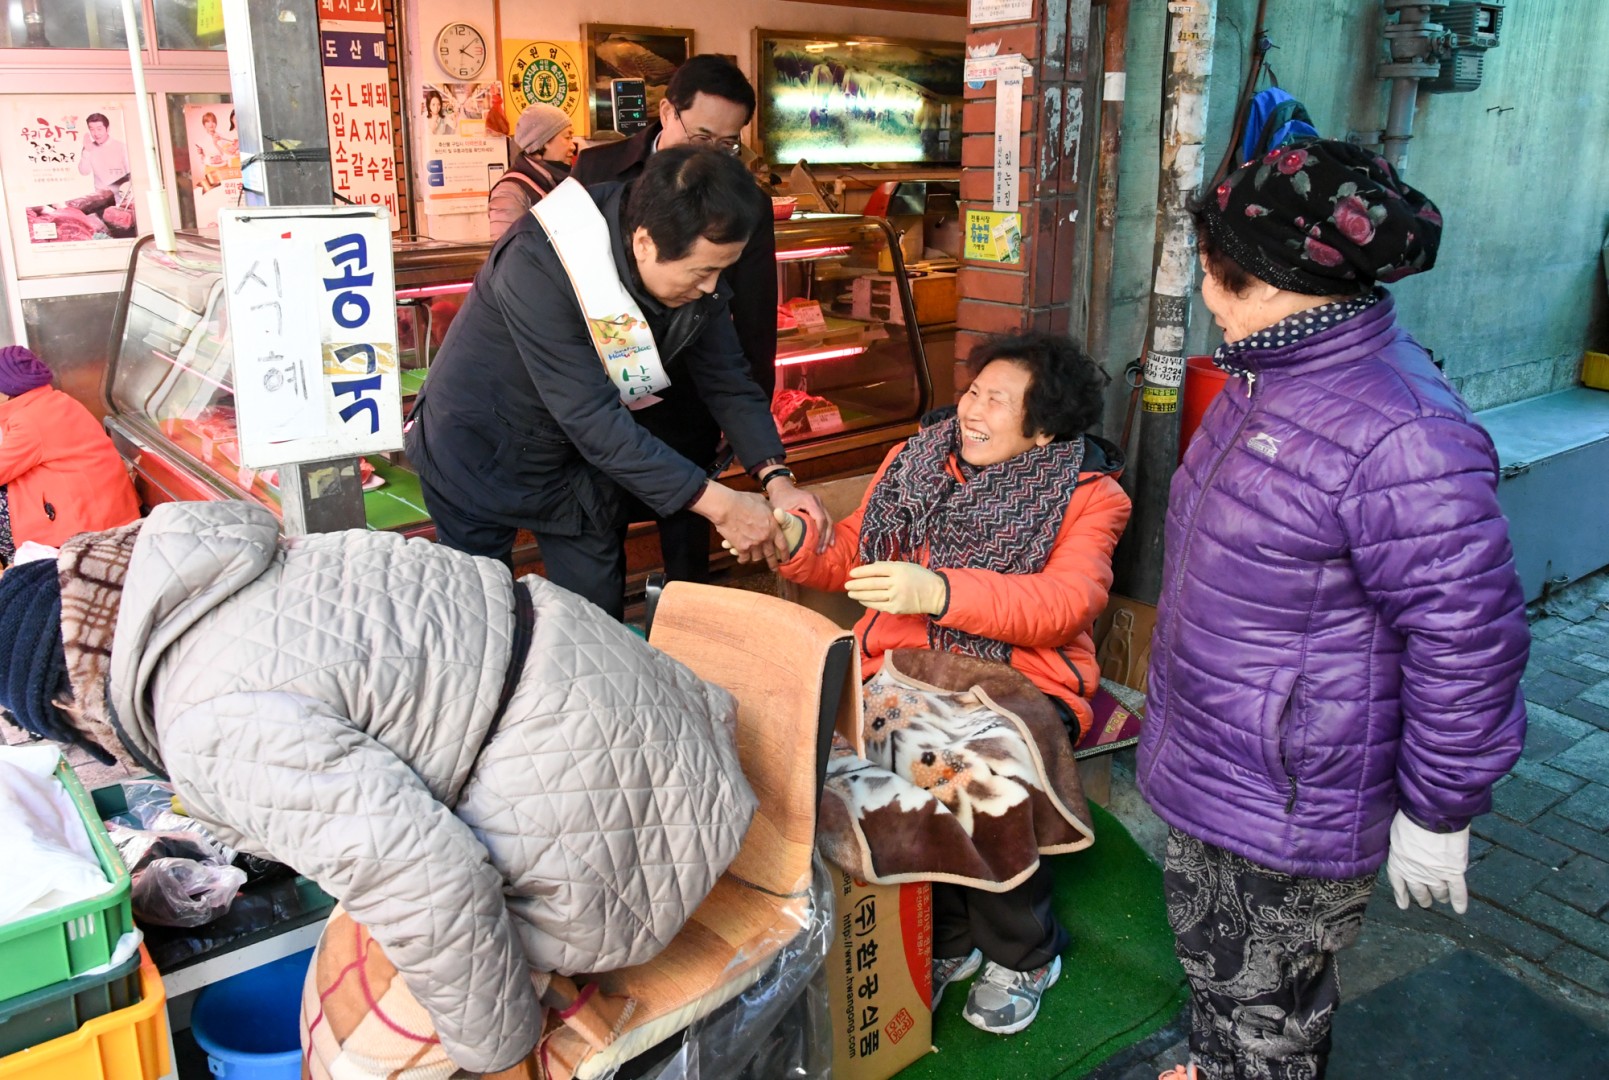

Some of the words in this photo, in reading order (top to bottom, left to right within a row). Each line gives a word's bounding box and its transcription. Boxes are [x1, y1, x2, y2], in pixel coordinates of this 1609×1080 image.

[455, 26, 466, 36] 12
[325, 39, 386, 61] 도산매
[440, 47, 449, 56] 9
[460, 68, 469, 76] 6
[322, 232, 383, 435] 콩국
[854, 894, 879, 1058] (주)환공식품
